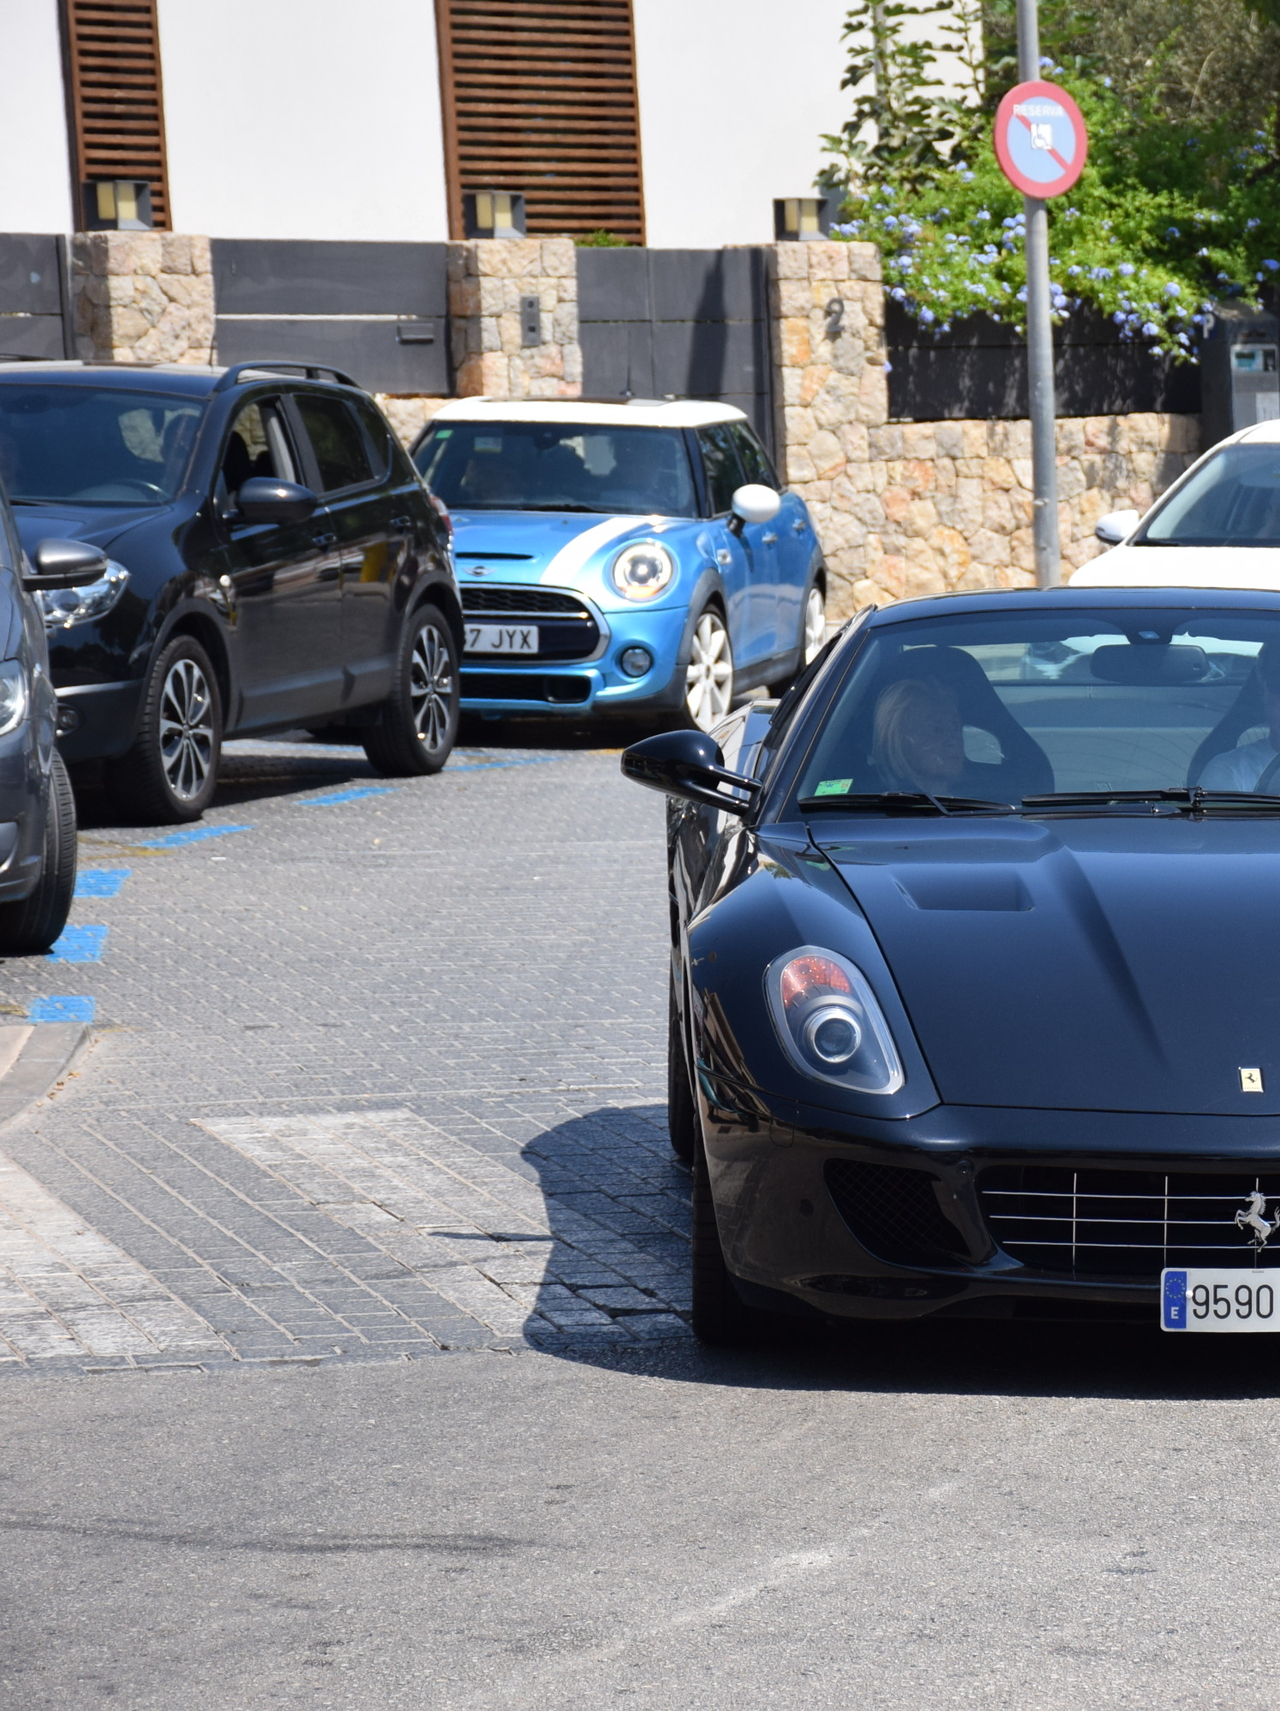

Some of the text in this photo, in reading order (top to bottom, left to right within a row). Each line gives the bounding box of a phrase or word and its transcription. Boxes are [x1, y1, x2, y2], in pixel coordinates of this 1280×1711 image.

[1013, 104, 1063, 117] RESERVA
[491, 629, 532, 649] JYX
[1191, 1284, 1274, 1320] 9590
[1170, 1307, 1180, 1320] E
